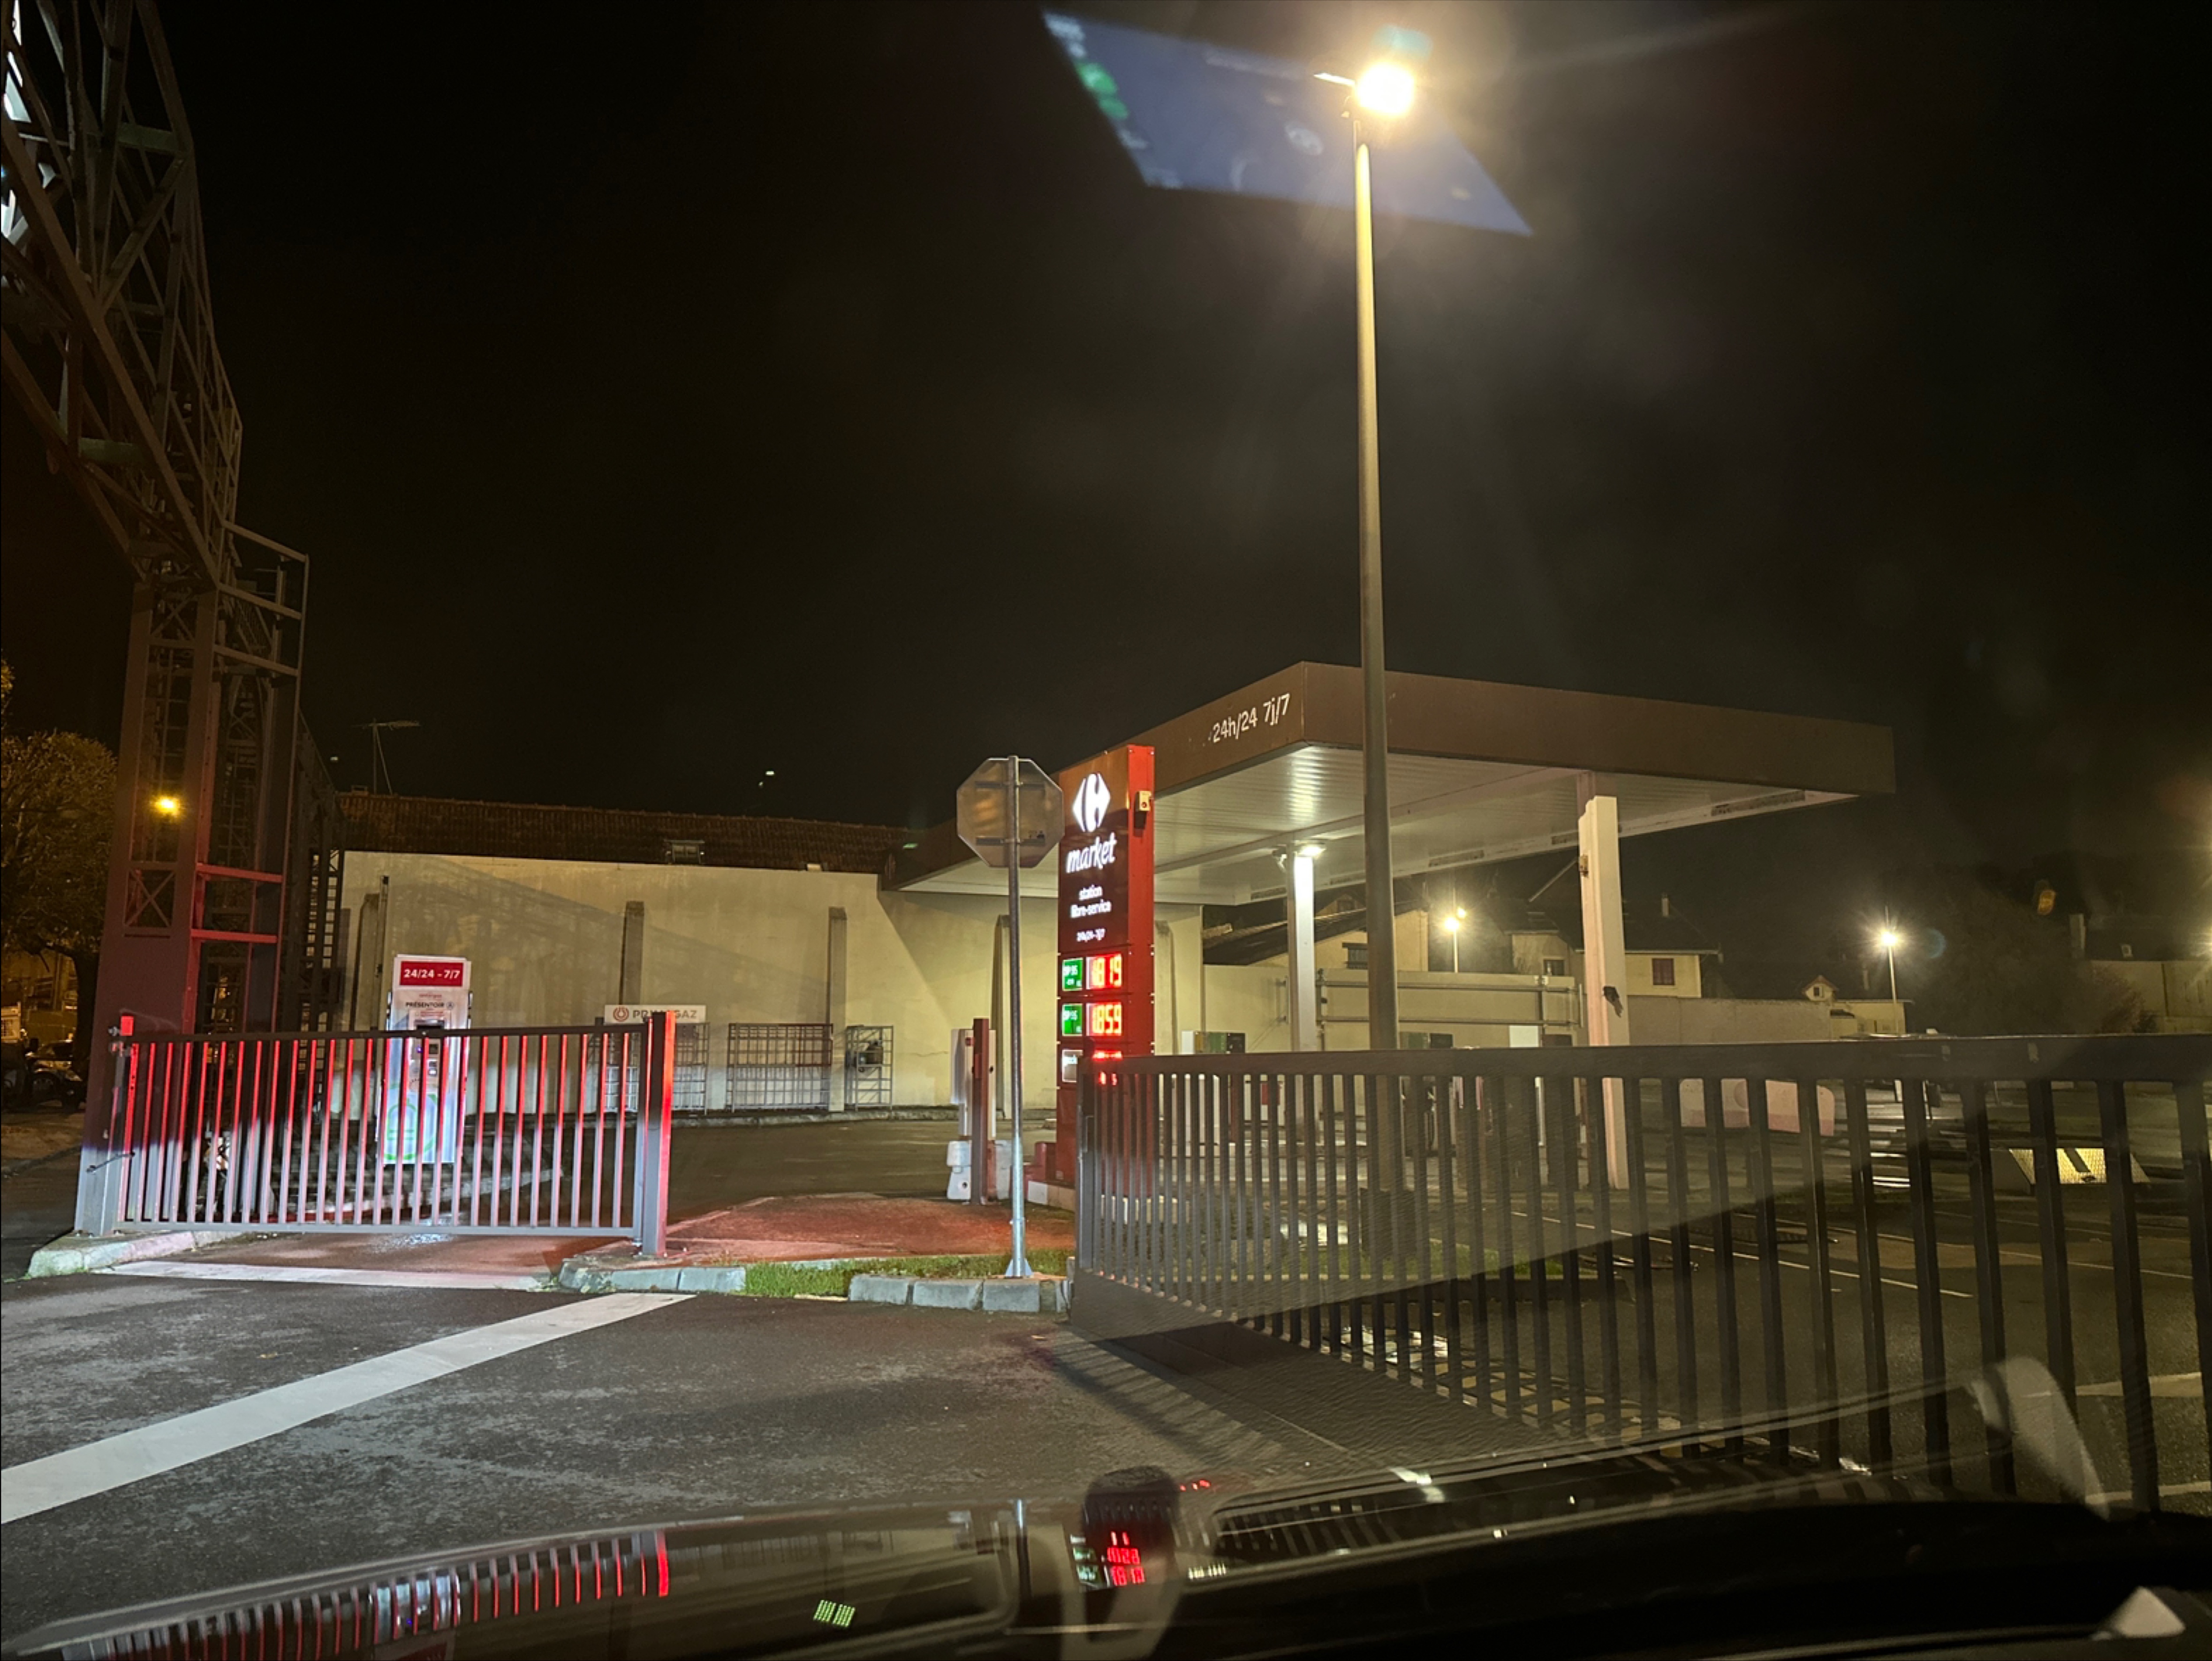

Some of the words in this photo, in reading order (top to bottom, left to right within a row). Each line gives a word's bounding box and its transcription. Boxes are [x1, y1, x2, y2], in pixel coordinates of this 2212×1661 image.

[1212, 706, 1258, 743] 24h/24
[1263, 692, 1290, 726] 7j/7
[1066, 832, 1117, 873] market
[404, 969, 434, 979] 24/24
[444, 969, 461, 980] 7/7
